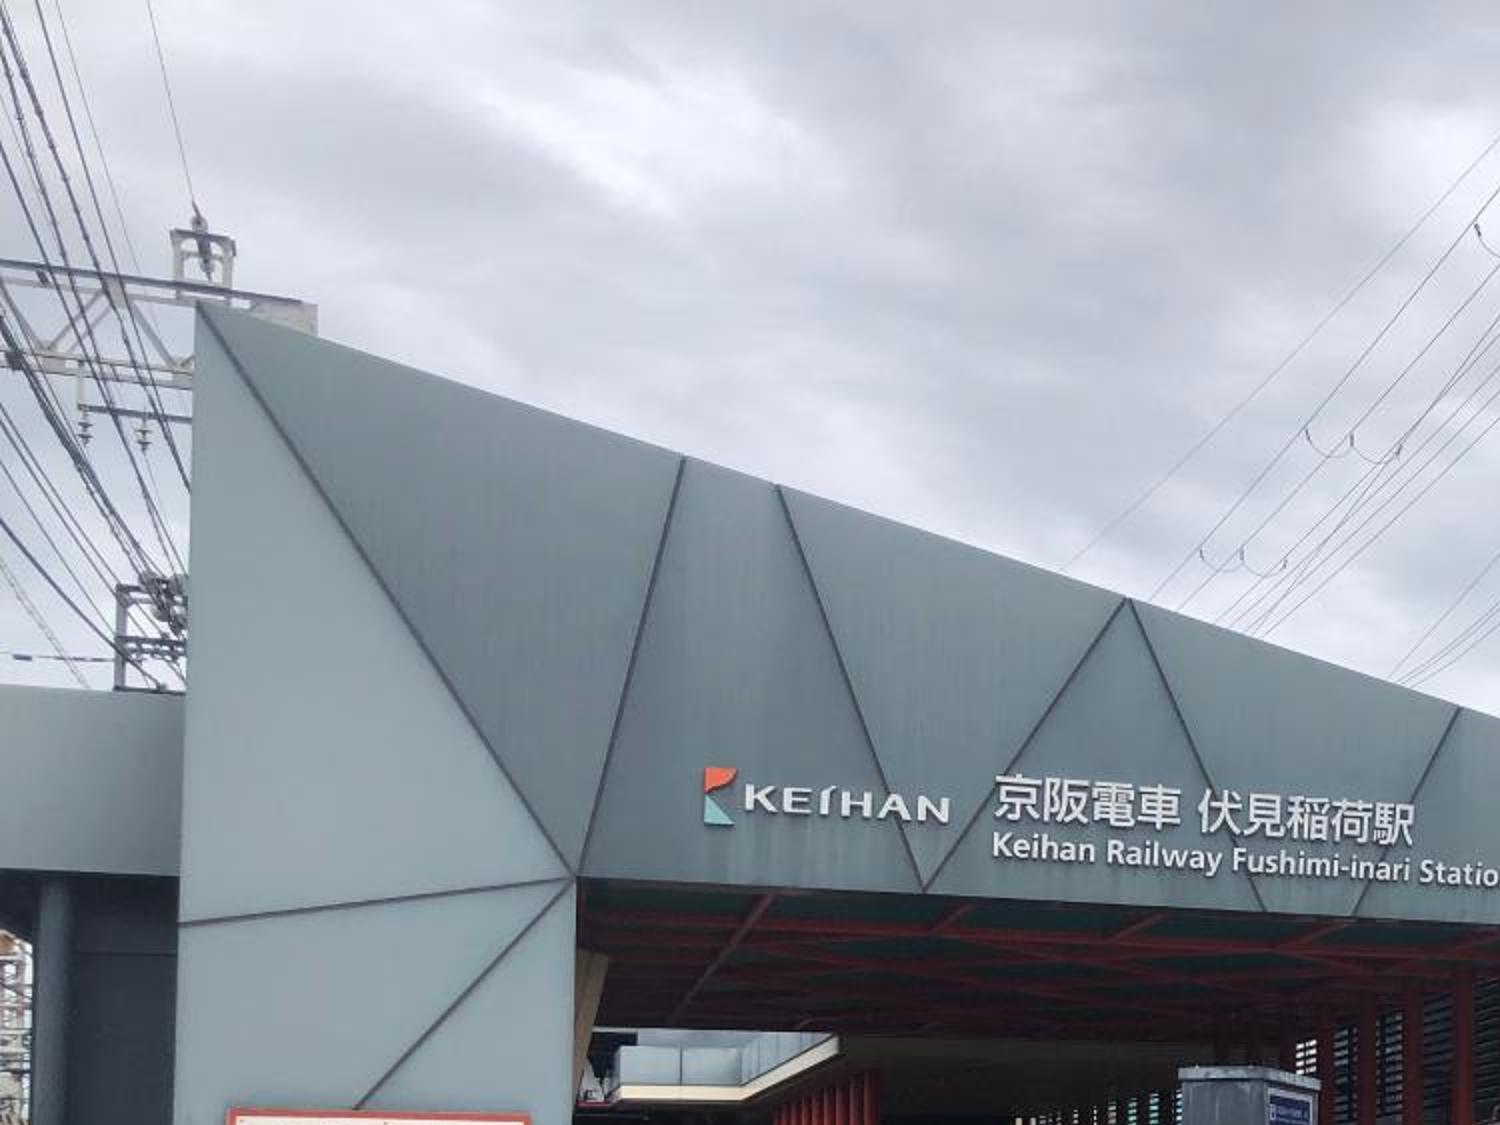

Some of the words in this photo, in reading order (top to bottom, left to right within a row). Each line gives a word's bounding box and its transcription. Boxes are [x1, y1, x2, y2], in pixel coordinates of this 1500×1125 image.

[744, 784, 950, 824] KEIHAN
[994, 773, 1182, 831] 京阪電車
[1198, 788, 1415, 847] 伏見稲荷駅
[992, 831, 1096, 863] Keihan
[1106, 838, 1223, 877] Railway
[1232, 847, 1411, 882] Fushimi-inari
